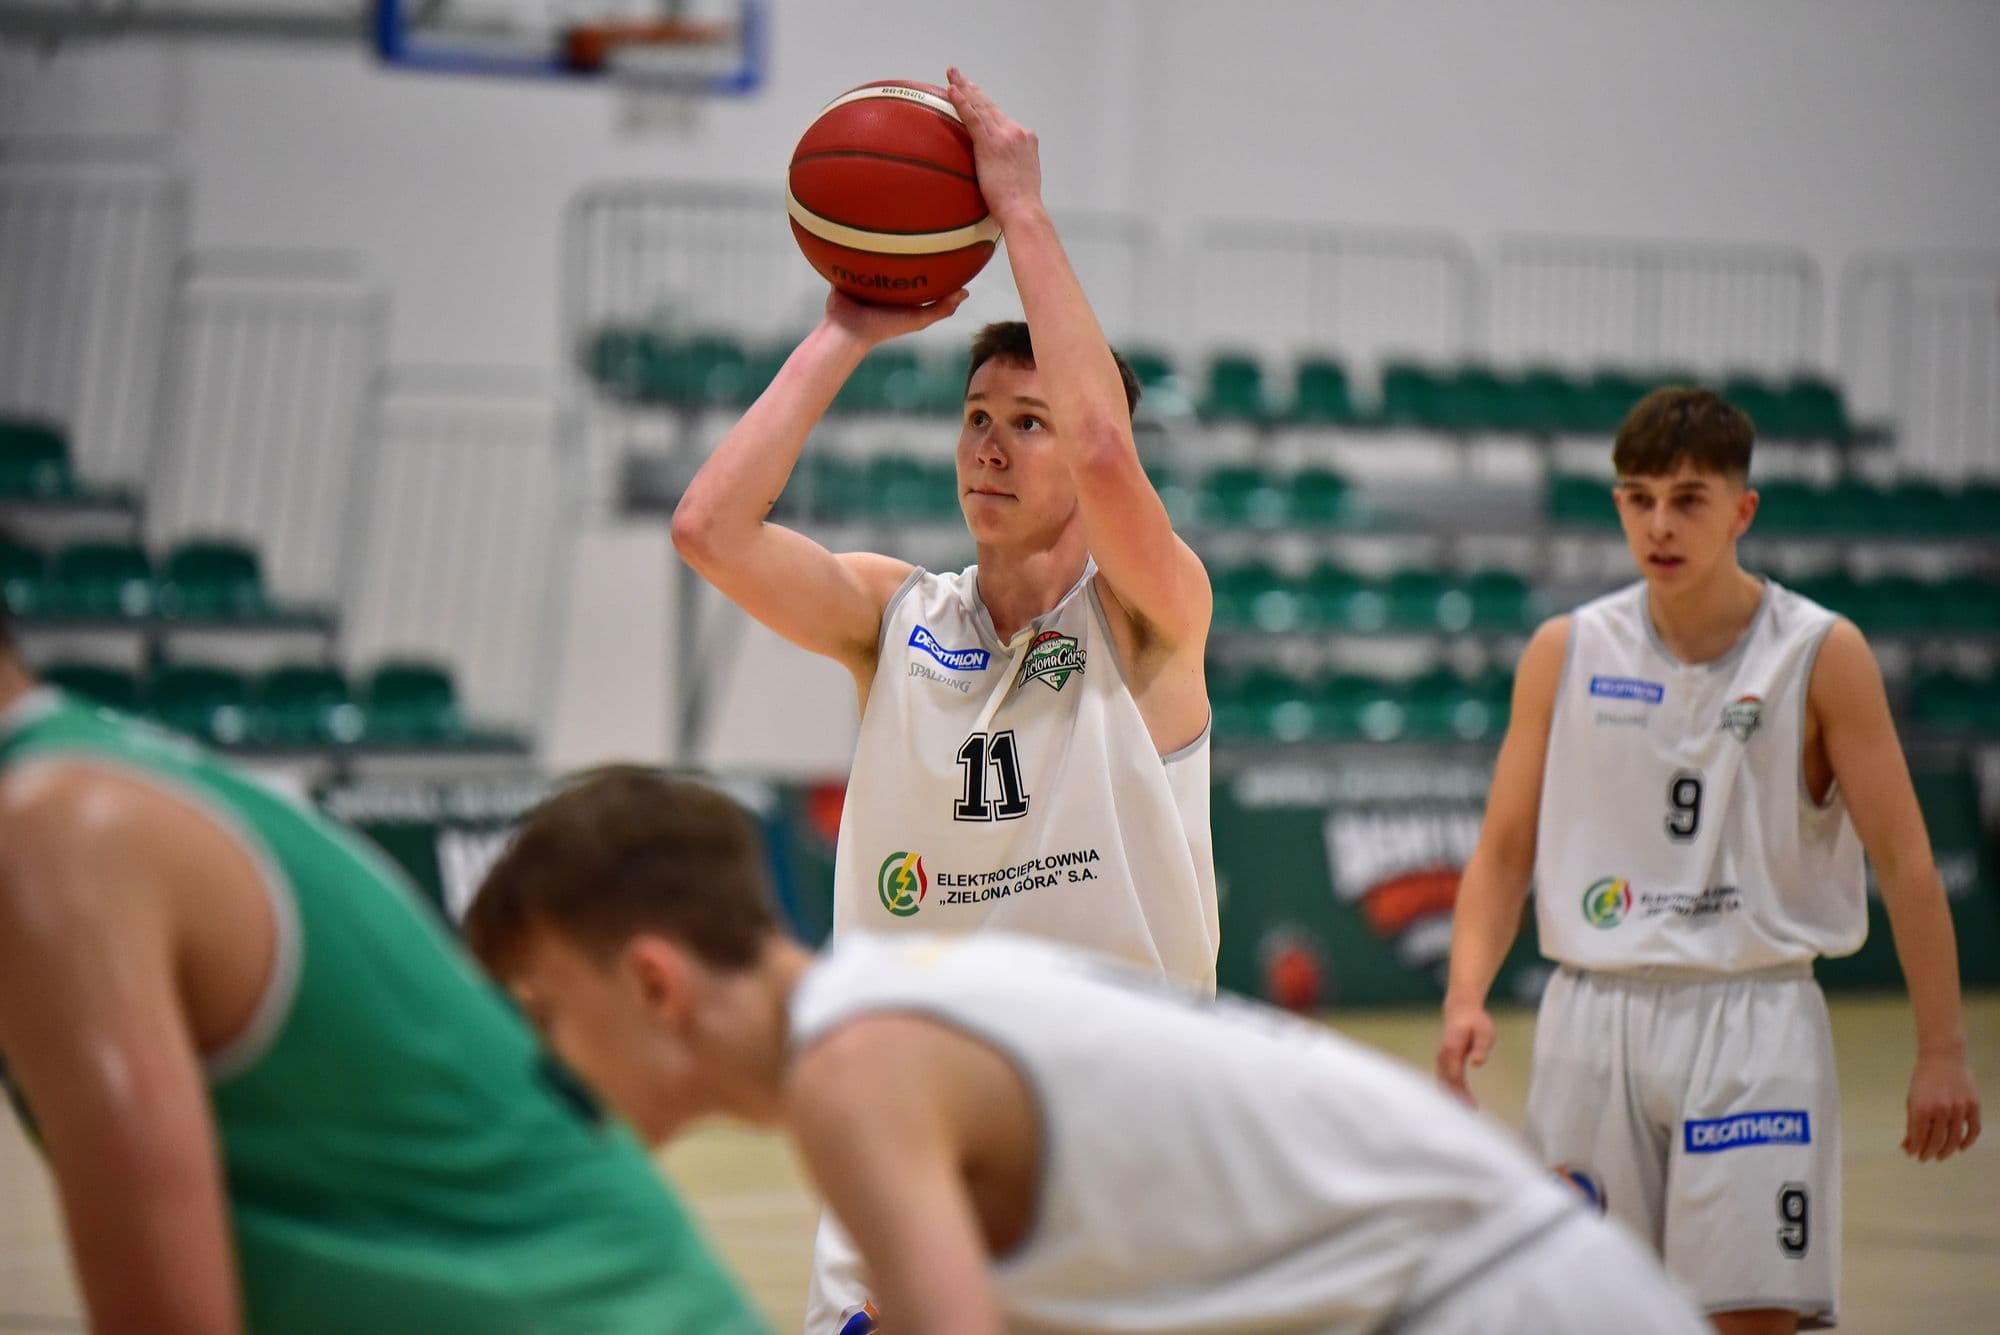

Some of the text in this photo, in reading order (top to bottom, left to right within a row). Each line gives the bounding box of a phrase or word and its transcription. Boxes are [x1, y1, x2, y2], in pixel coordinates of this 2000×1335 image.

[831, 264, 928, 289] molten
[913, 629, 984, 667] DECATHLON
[908, 661, 971, 694] SPALDING
[954, 730, 1030, 822] 11
[1664, 769, 1705, 843] 9
[937, 848, 1100, 887] ELEKTROCIEPŁOWNIA
[1068, 867, 1098, 883] S.A.
[1691, 1115, 1802, 1147] DECATHLON
[1776, 1181, 1809, 1260] 9
